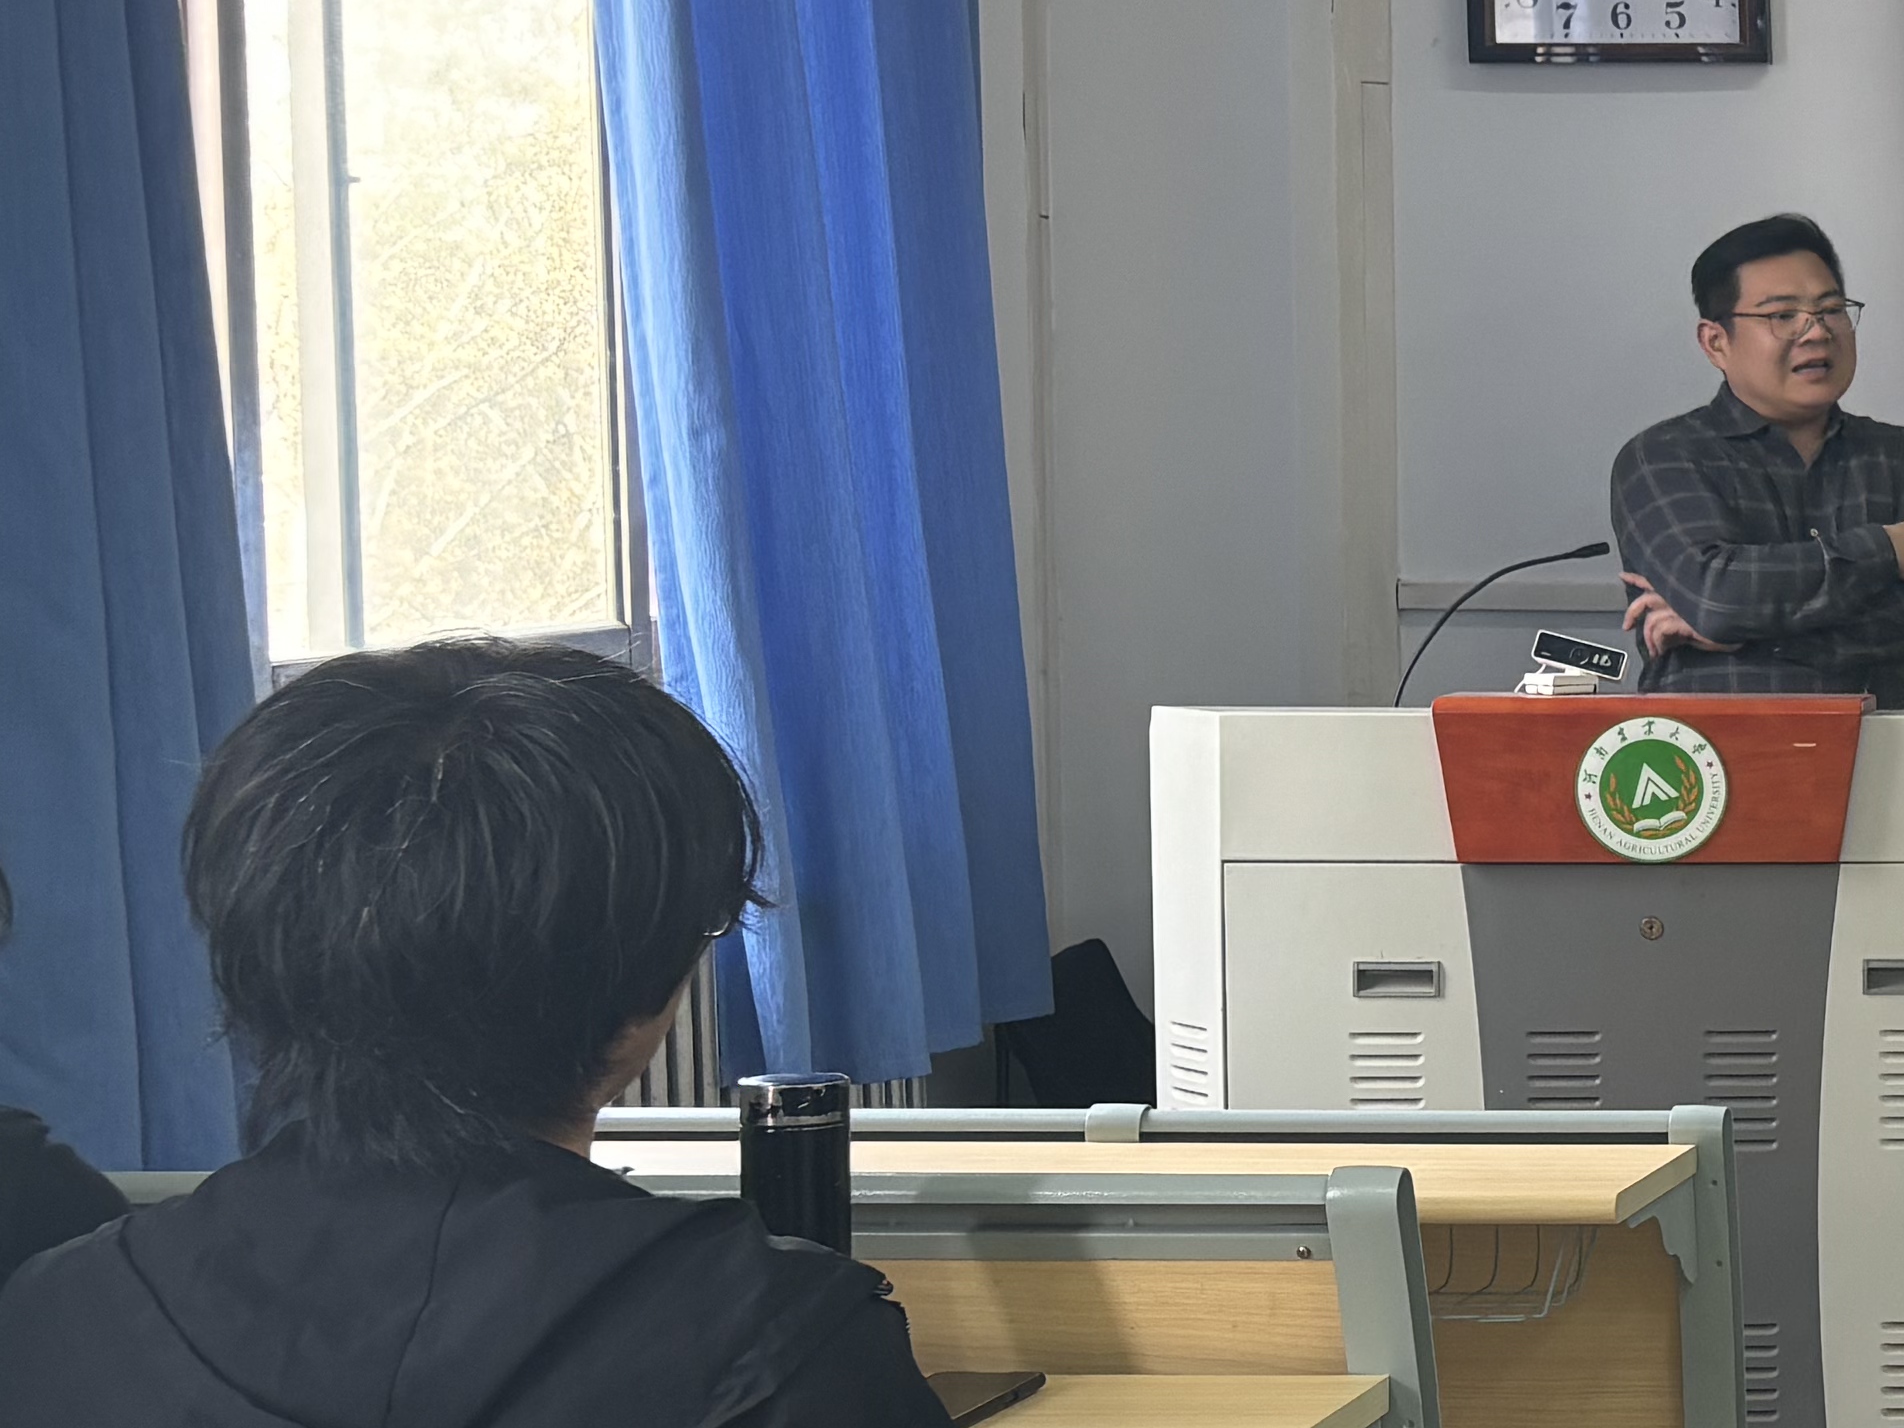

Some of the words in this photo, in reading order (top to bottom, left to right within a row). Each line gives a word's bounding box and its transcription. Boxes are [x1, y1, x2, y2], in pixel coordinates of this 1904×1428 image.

[1556, 2, 1577, 30] 7
[1611, 2, 1632, 30] 6
[1664, 0, 1686, 30] 5
[1588, 808, 1614, 840] HENAN
[1616, 833, 1697, 856] AGRICULTURAL
[1696, 772, 1721, 833] UNIVERSITY
